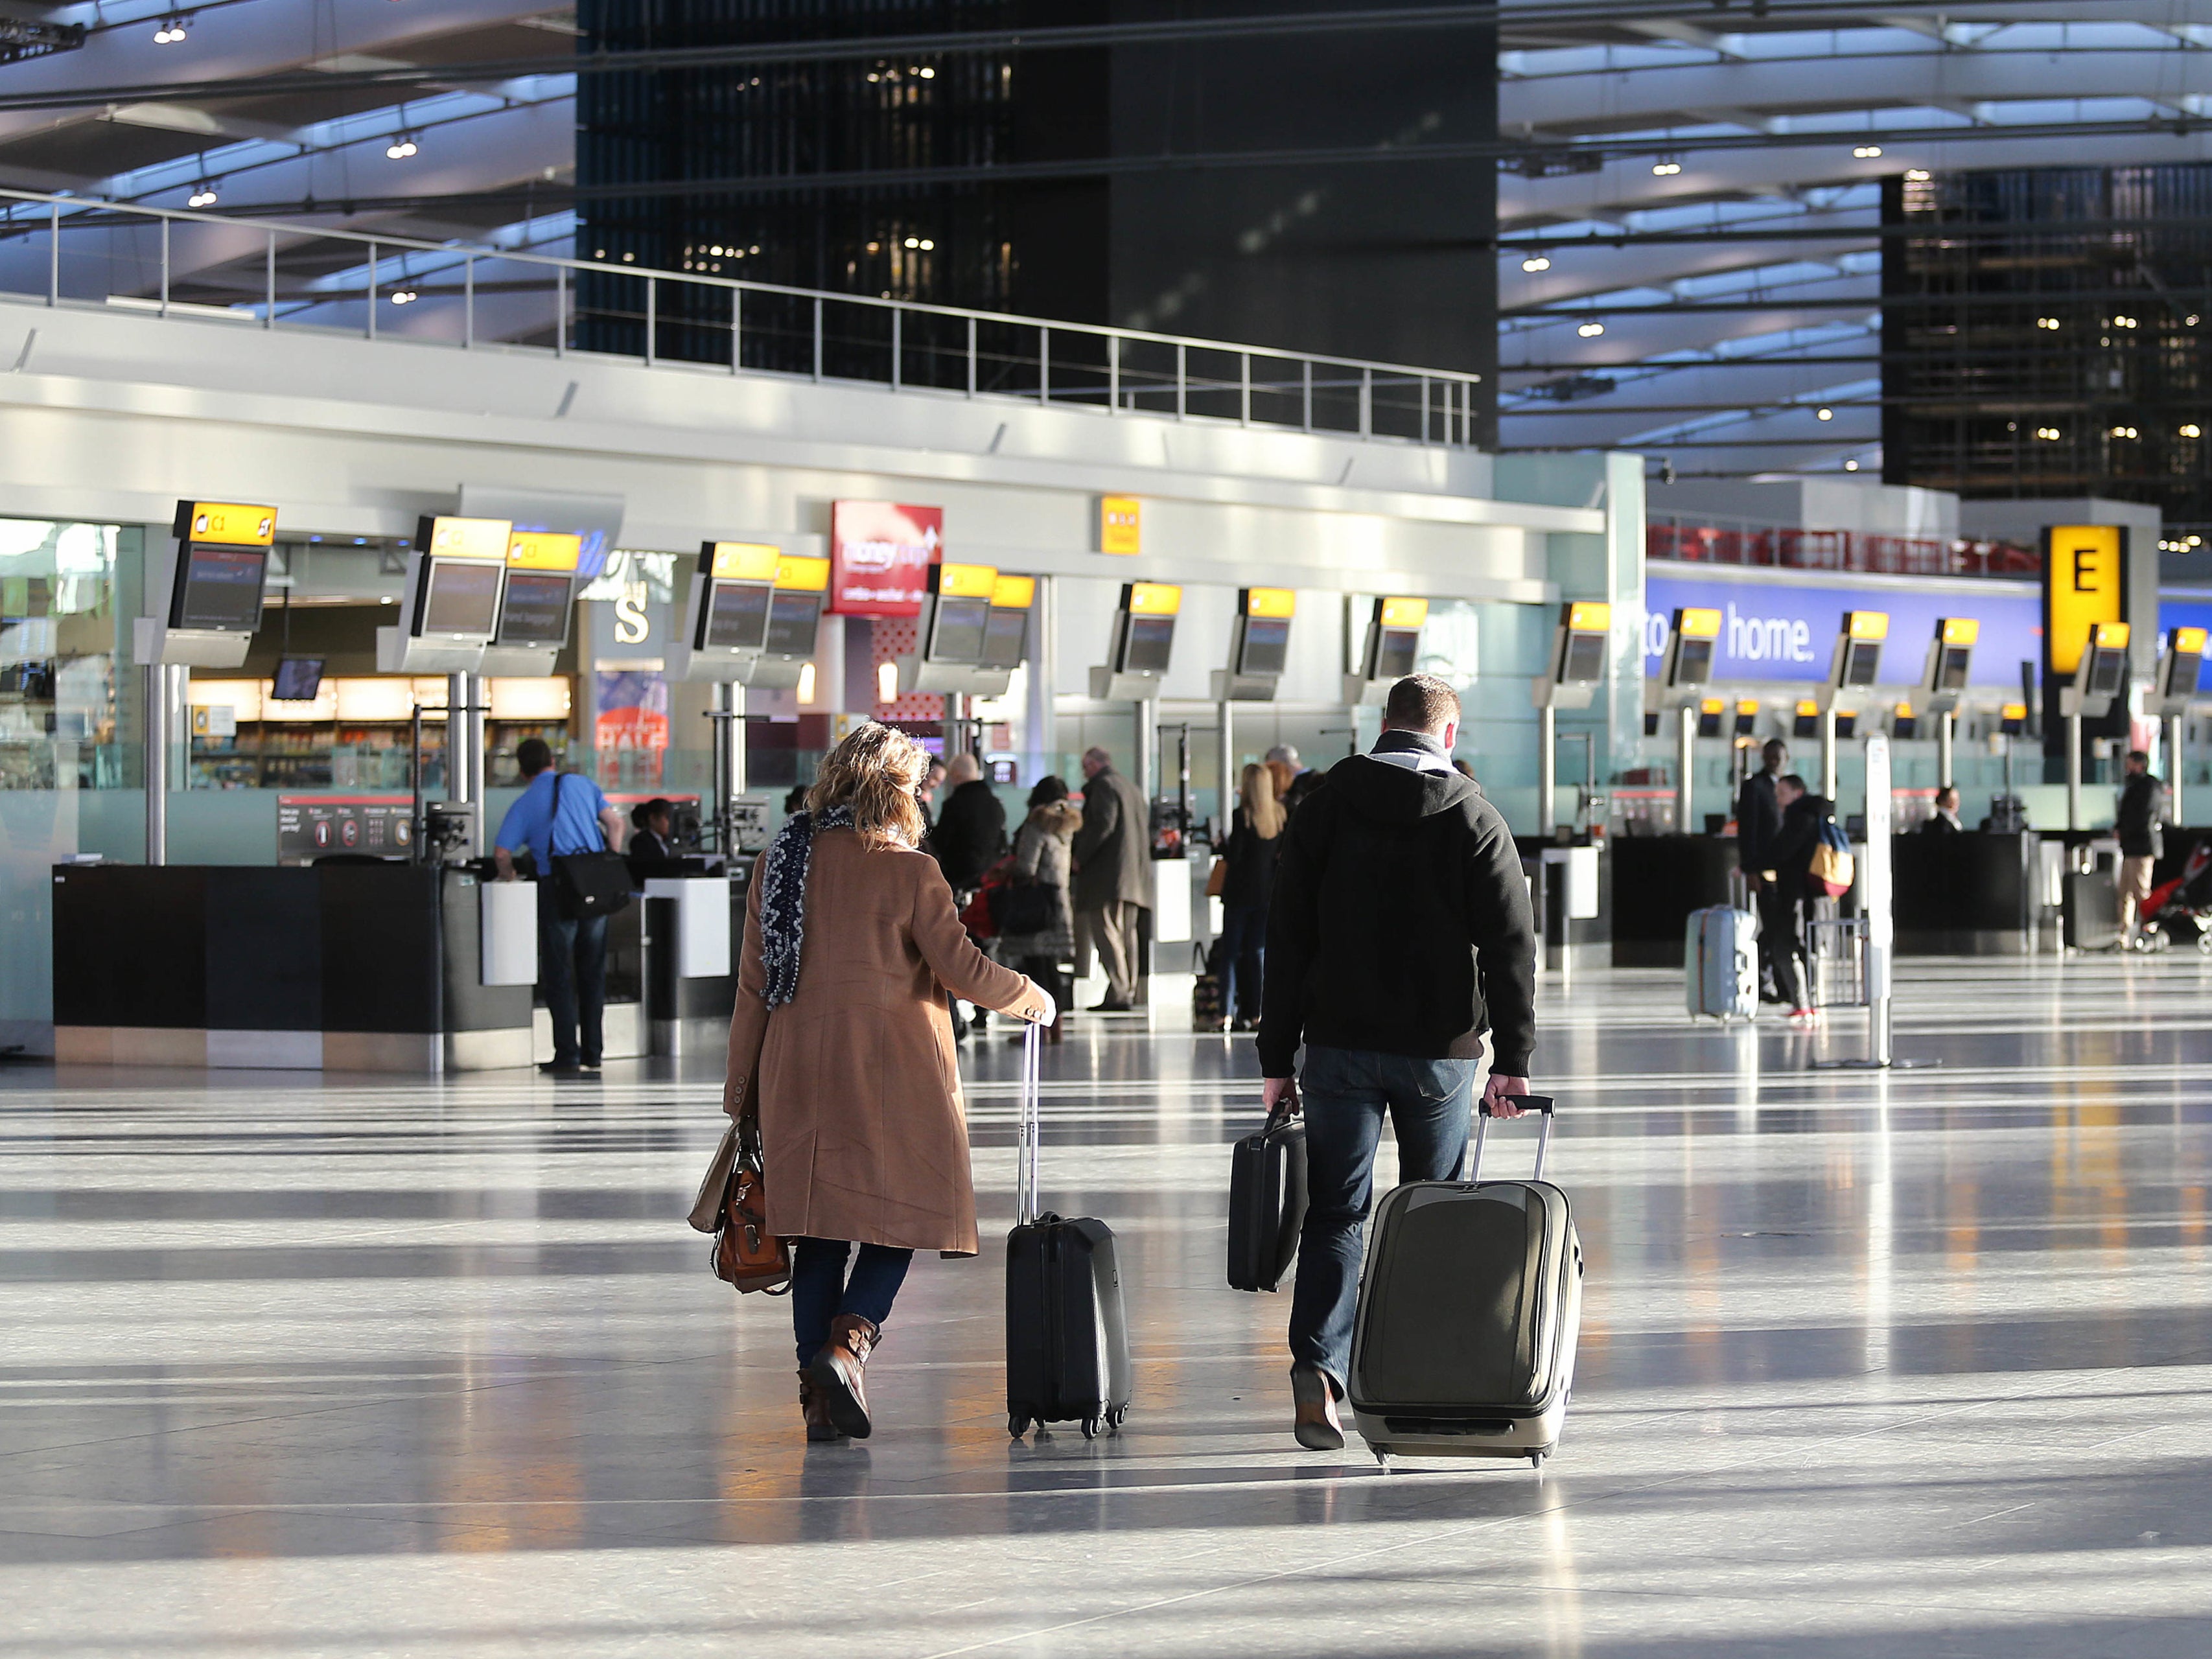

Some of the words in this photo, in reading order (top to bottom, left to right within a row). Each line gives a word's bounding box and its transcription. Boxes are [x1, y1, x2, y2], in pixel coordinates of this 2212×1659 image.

[211, 515, 225, 531] C1
[2074, 549, 2098, 592] E
[1727, 600, 1815, 662] home.
